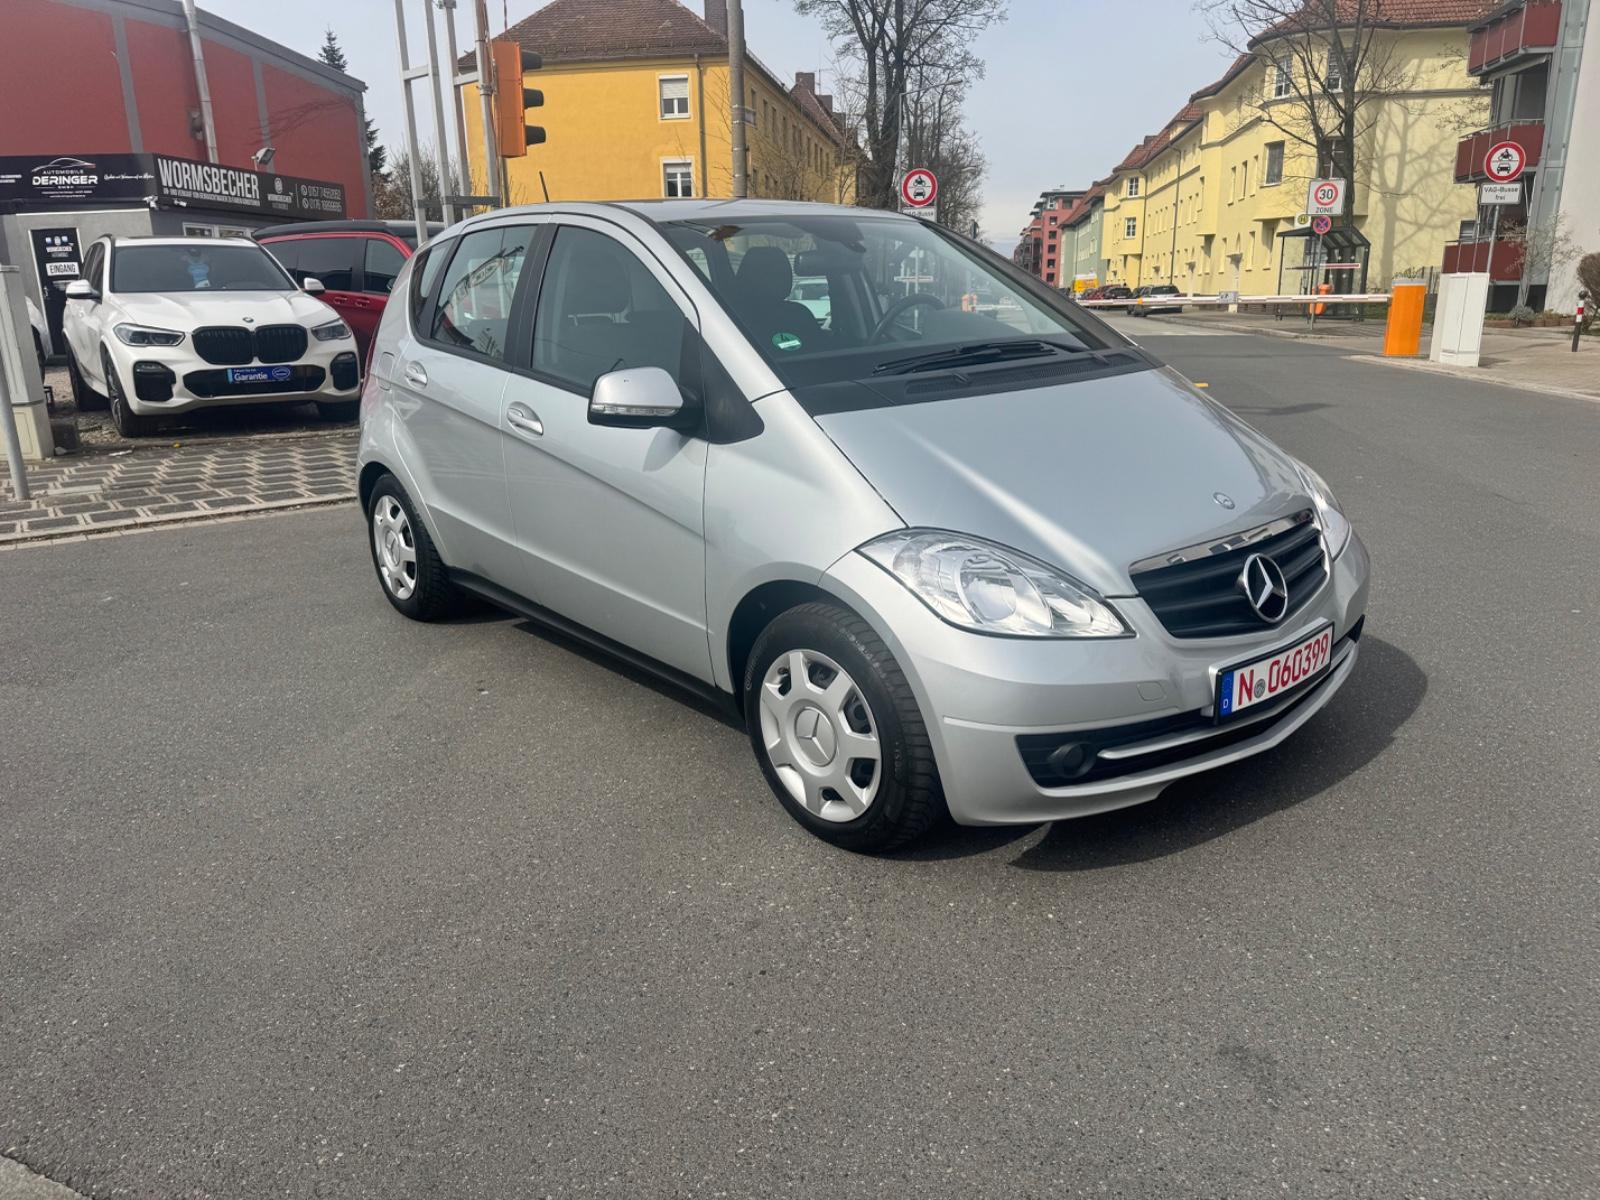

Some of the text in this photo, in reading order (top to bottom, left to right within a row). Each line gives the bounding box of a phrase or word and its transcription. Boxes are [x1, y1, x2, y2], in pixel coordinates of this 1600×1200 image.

[32, 175, 98, 186] DERINGER
[157, 158, 260, 199] WORMSBECHER
[1319, 188, 1334, 200] 30
[50, 263, 76, 273] EINGANG
[234, 372, 268, 381] Garantie
[1238, 633, 1329, 706] N 060399
[1222, 698, 1229, 709] D
